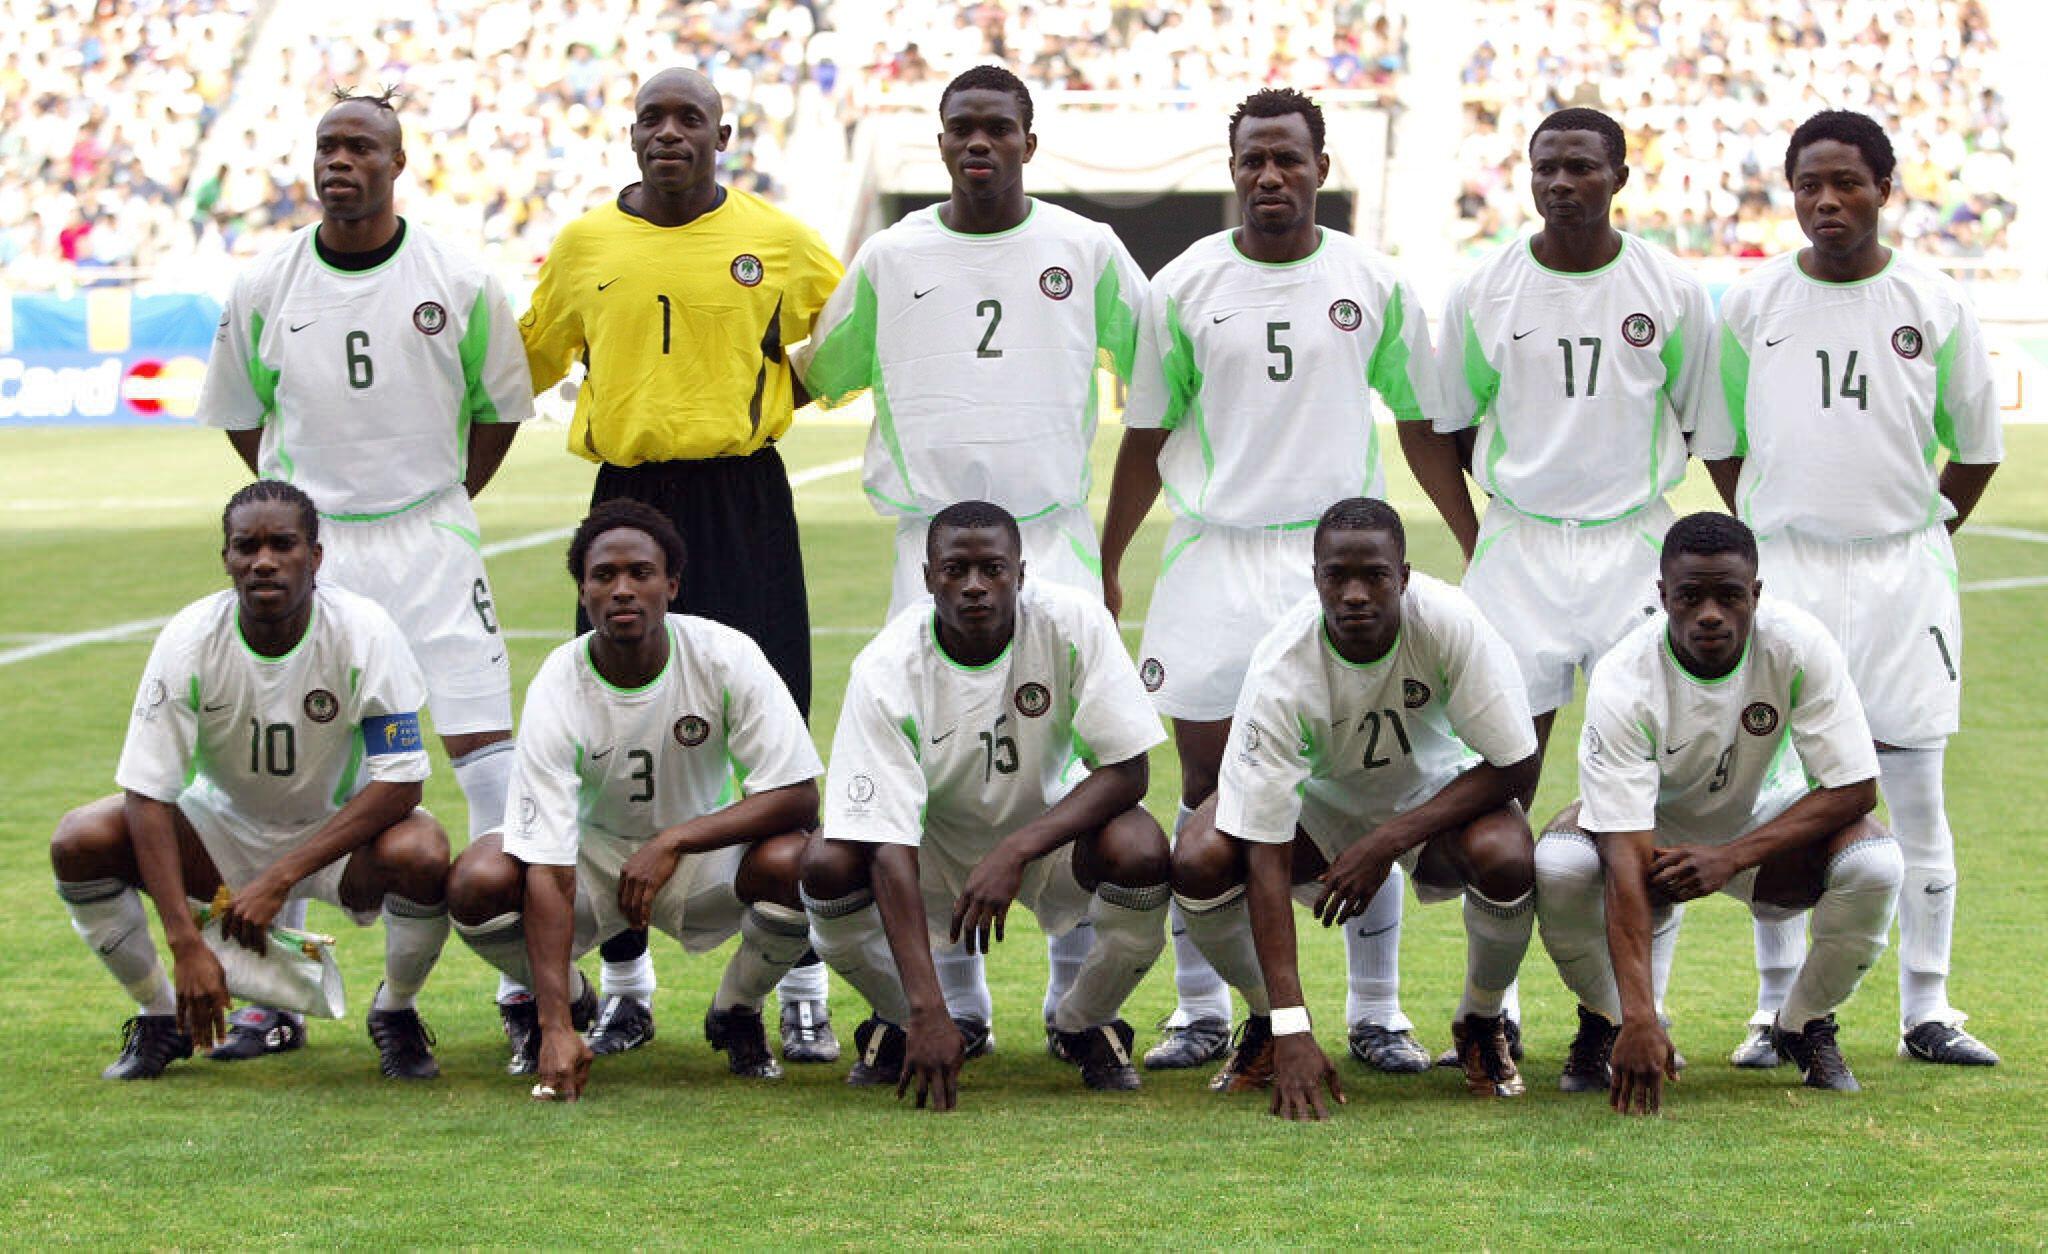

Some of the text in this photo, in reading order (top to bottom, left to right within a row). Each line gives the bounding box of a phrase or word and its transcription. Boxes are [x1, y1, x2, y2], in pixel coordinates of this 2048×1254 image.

[656, 294, 671, 355] 1
[976, 299, 1003, 358] 2
[1266, 321, 1293, 382] 5
[346, 330, 374, 389] 6
[1558, 337, 1602, 398] 17
[1816, 350, 1867, 411] 14
[250, 717, 296, 777] 10
[979, 714, 1019, 784] 15
[1357, 709, 1412, 769] 21
[627, 749, 655, 803] 3
